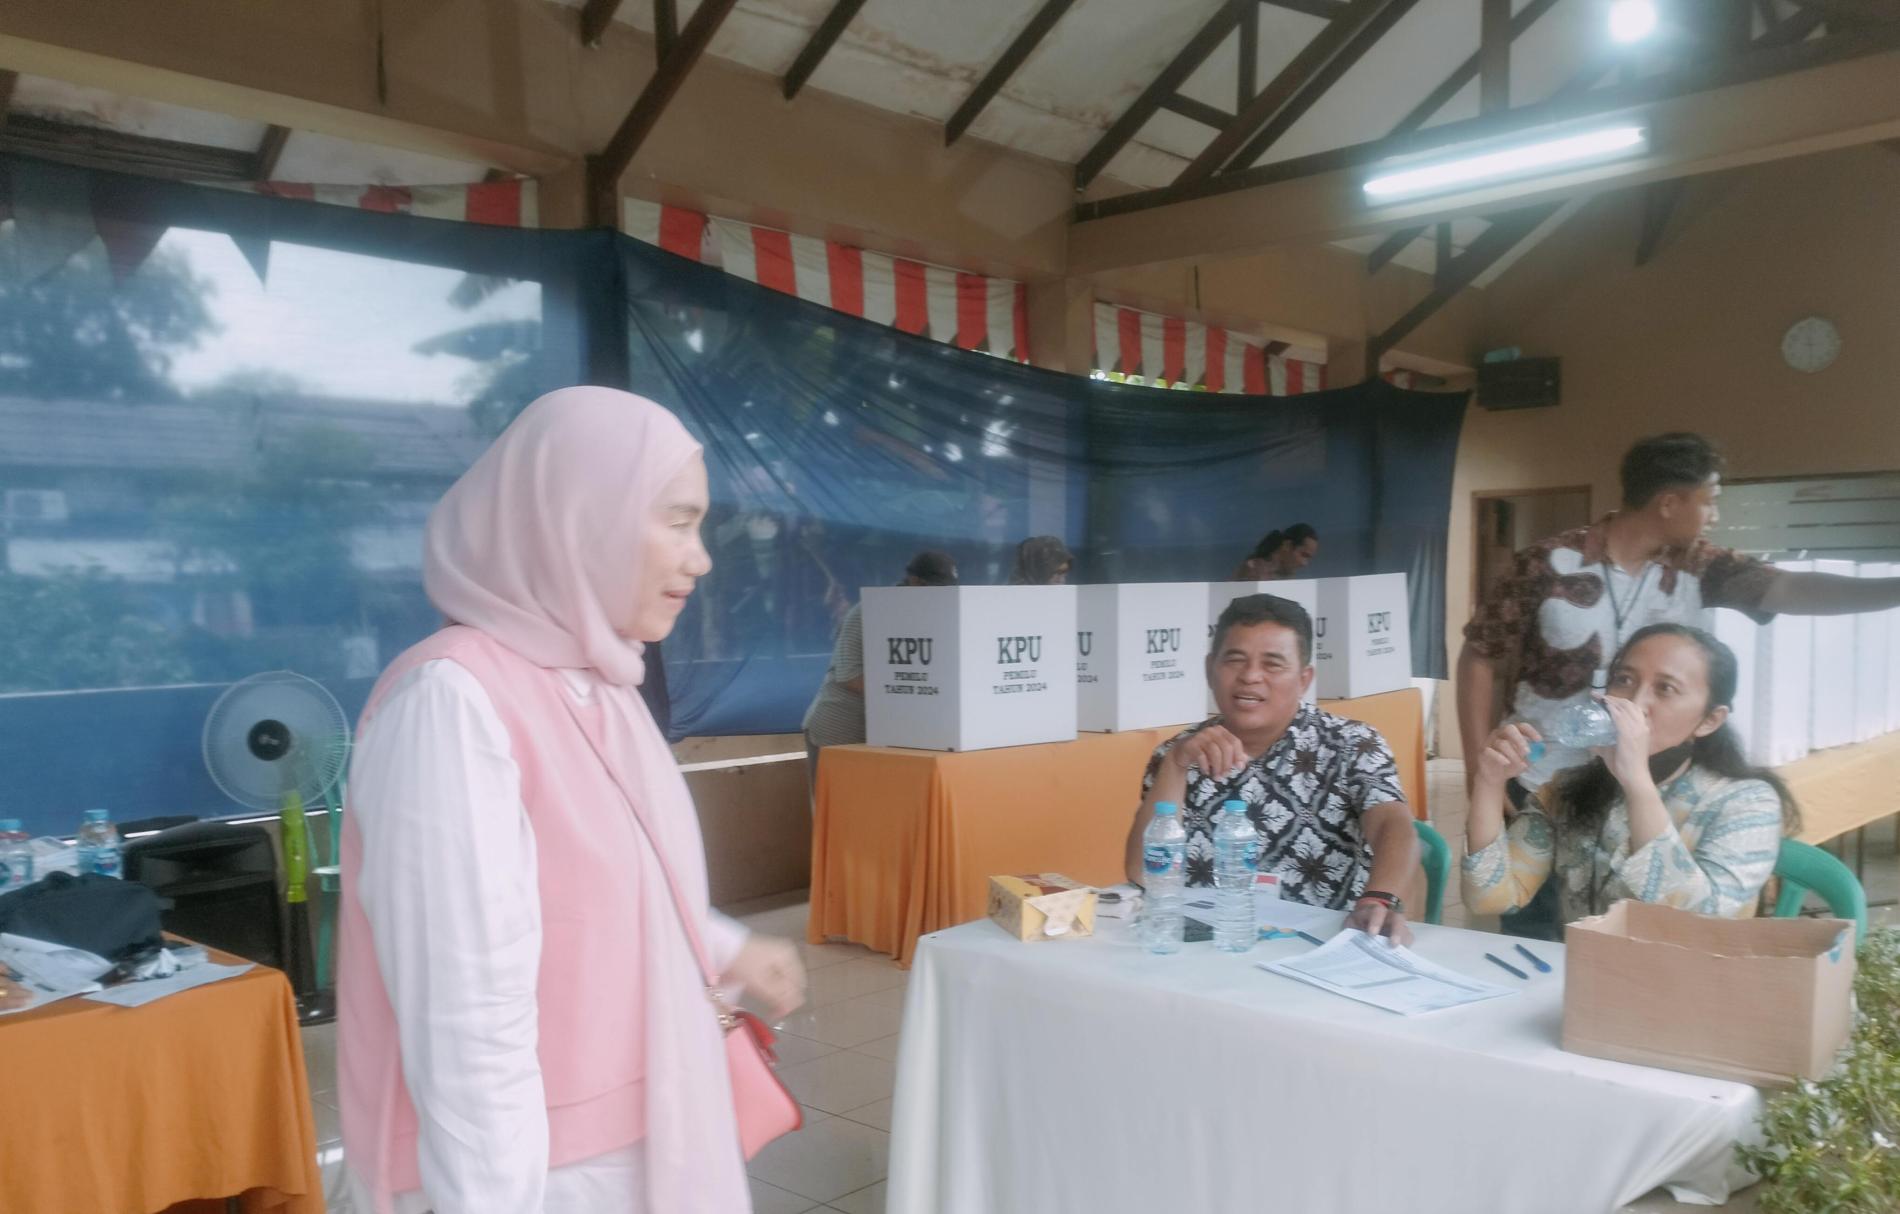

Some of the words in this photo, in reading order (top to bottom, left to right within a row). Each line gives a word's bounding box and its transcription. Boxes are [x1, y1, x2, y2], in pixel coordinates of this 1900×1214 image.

[1367, 611, 1391, 633] KPU
[1146, 628, 1181, 653] KPU
[888, 637, 933, 666] KPU
[997, 635, 1042, 664] KPU
[894, 671, 928, 681] PEMILU
[1003, 669, 1037, 680] PEMILU
[885, 685, 914, 694] TAHUN
[917, 686, 939, 695] 2024
[993, 684, 1024, 694] TAHUN
[1026, 682, 1048, 693] 2024
